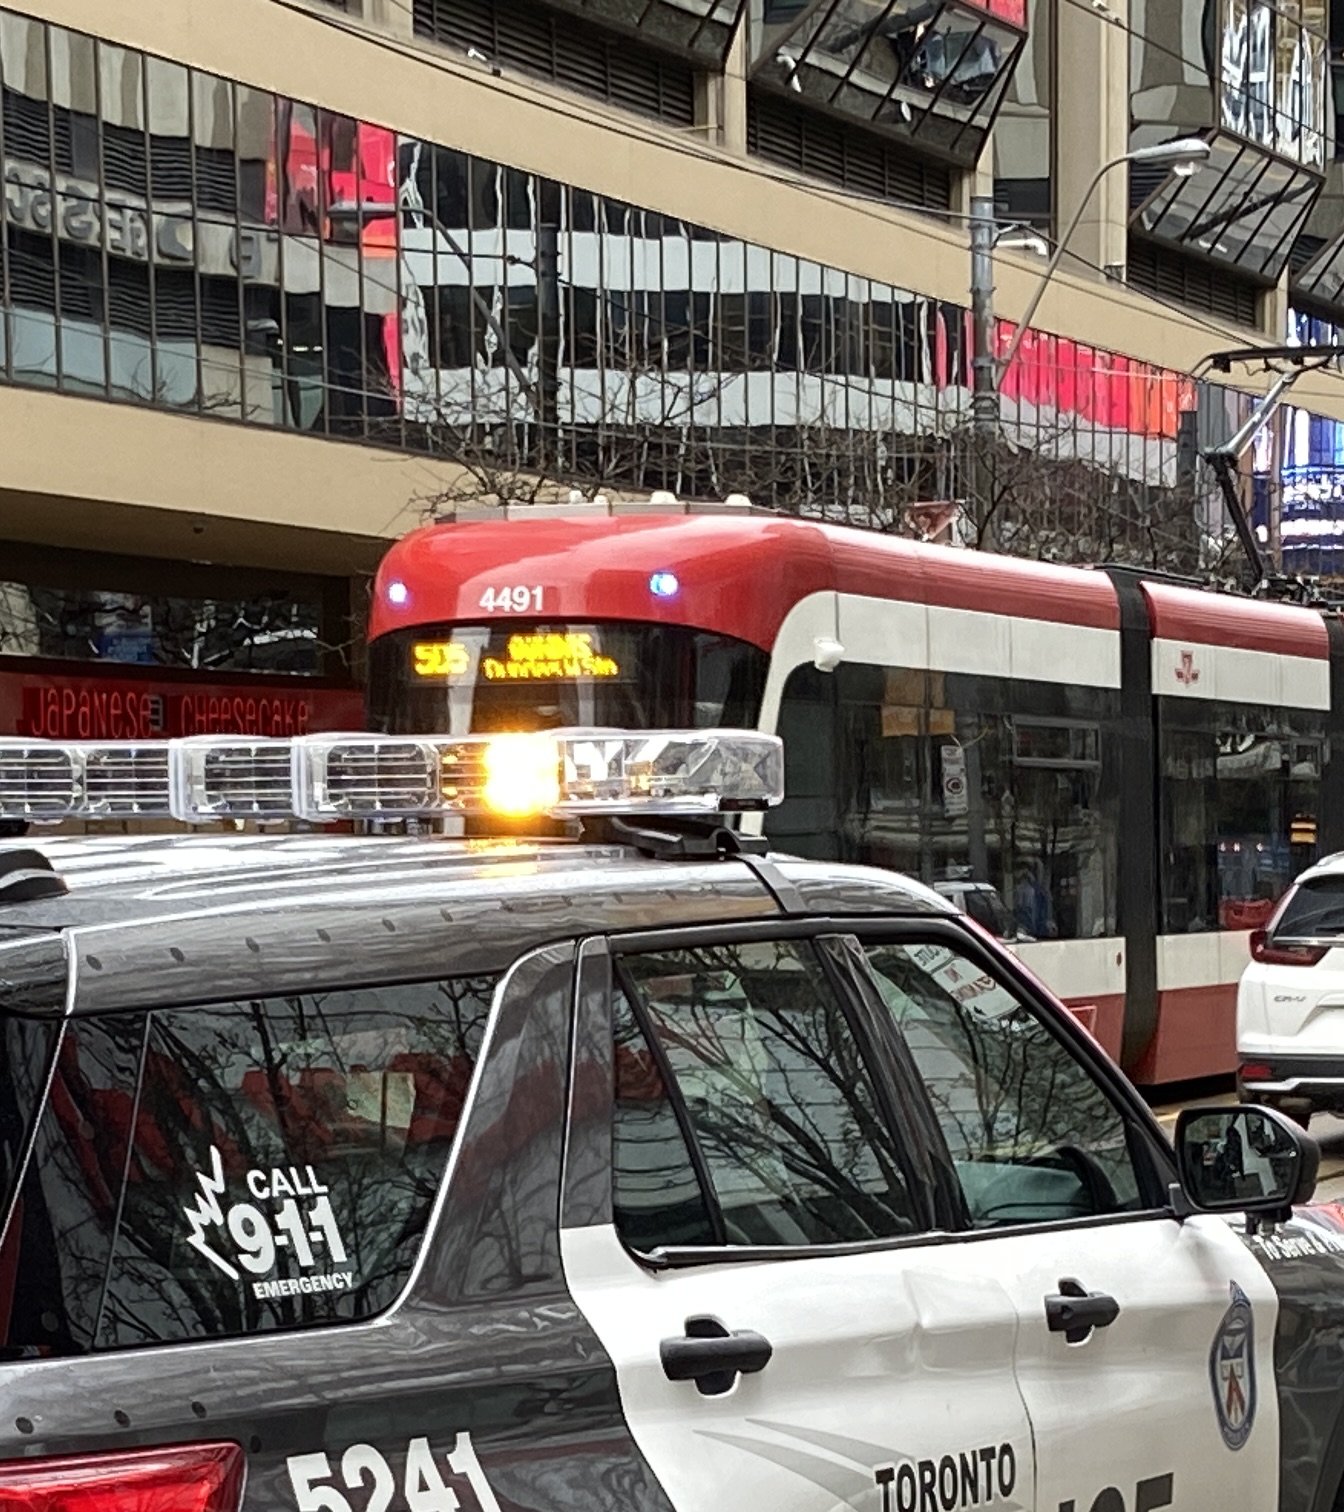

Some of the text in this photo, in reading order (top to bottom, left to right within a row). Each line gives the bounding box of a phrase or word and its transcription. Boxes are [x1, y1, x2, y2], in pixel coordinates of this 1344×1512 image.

[479, 585, 544, 612] 4491
[246, 1165, 329, 1199] CALL
[227, 1196, 348, 1274] 9-1-1
[252, 1271, 353, 1300] EMERGENCY
